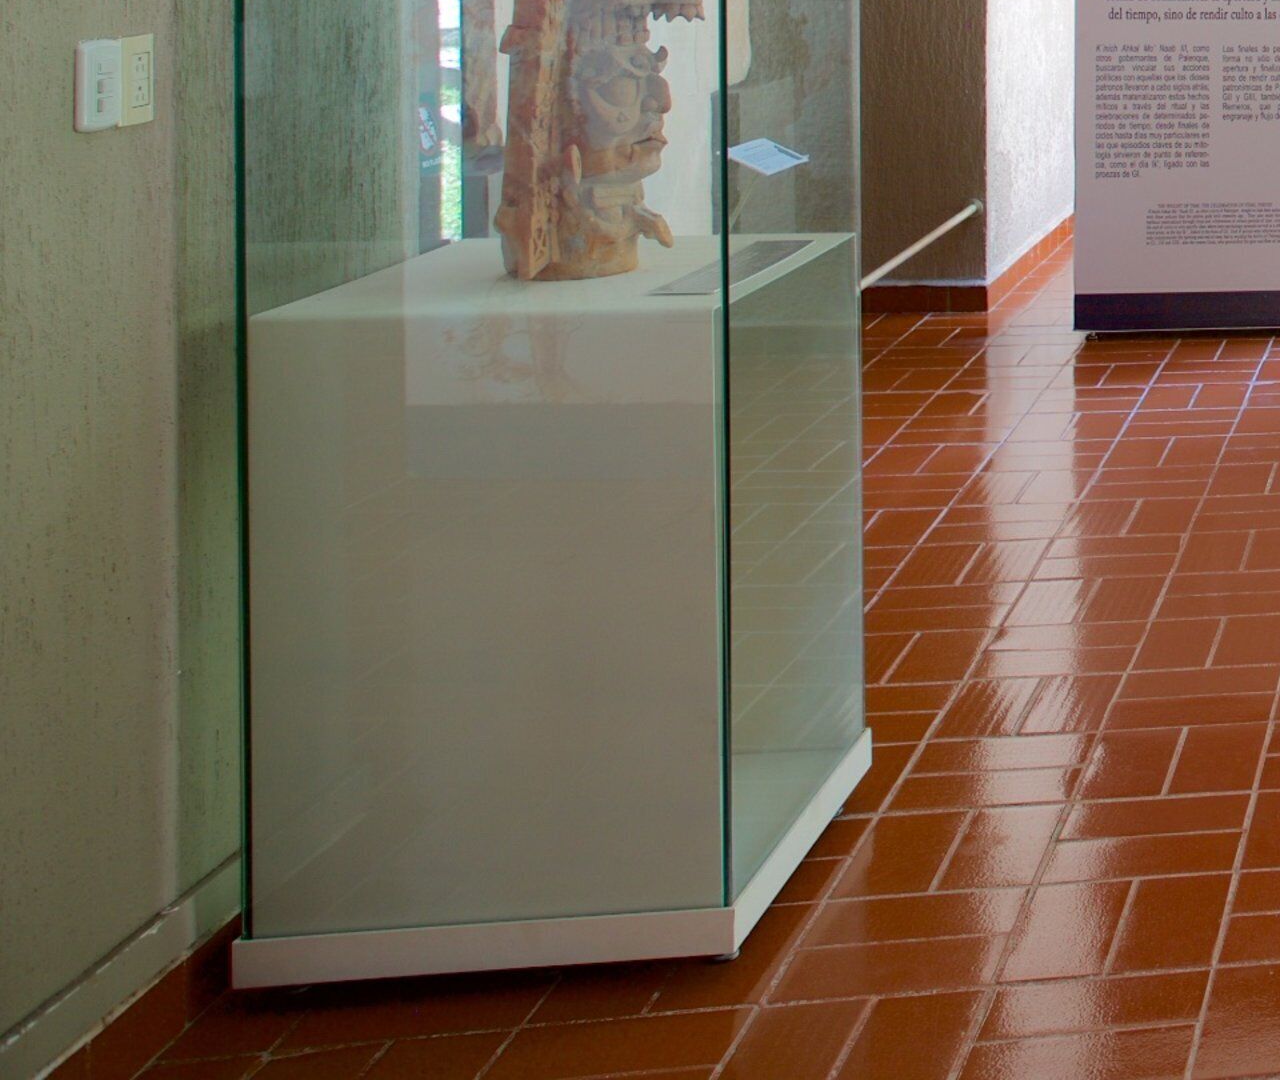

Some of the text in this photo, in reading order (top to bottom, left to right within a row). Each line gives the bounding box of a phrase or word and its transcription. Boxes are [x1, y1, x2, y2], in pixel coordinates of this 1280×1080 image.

[1108, 7, 1122, 20] del
[1125, 7, 1161, 24] tiempo,
[1164, 7, 1183, 20] sino
[1185, 7, 1197, 20] de
[1200, 7, 1228, 20] rendir
[1230, 7, 1254, 20] culto
[1256, 11, 1262, 20] a
[1264, 7, 1277, 20] las
